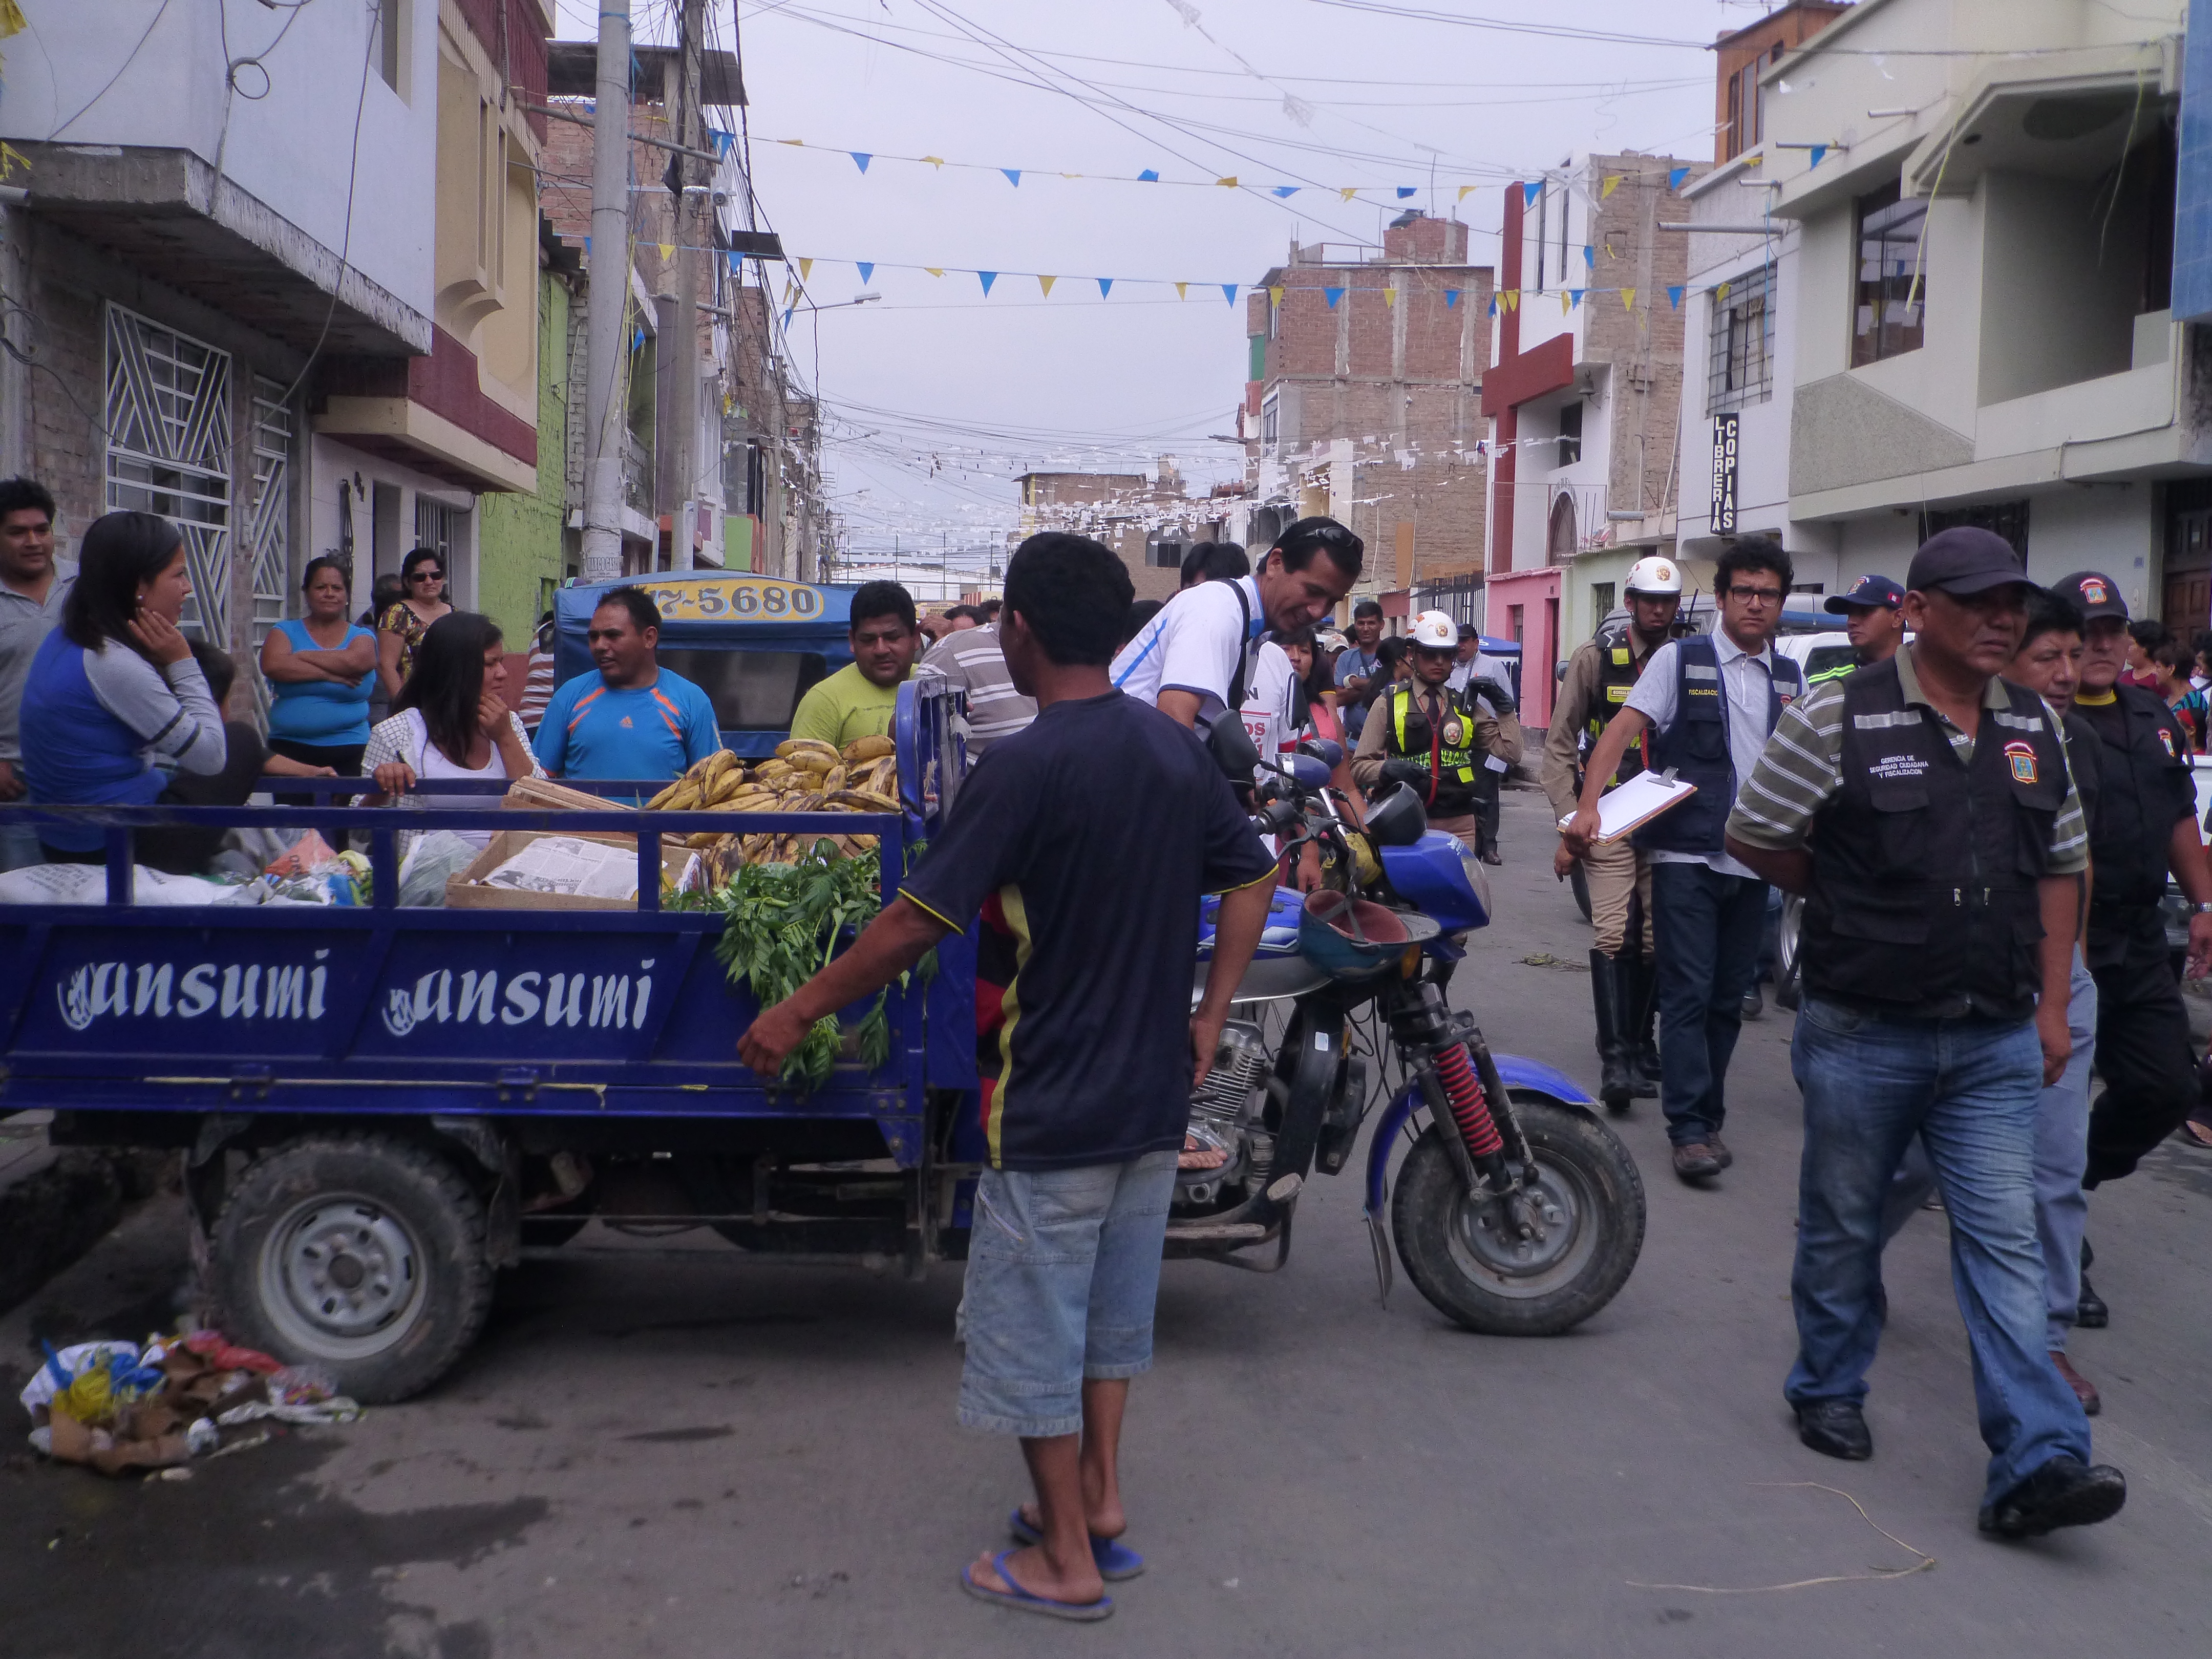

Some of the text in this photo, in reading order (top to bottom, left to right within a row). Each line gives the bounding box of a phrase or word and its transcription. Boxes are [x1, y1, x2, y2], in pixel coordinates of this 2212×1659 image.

[1712, 416, 1725, 531] LIBRERIA
[1722, 420, 1736, 528] COPIAS
[587, 557, 605, 571] MARCO
[649, 586, 816, 616] 7-5680
[1881, 755, 1906, 764] GERENCIA
[1869, 763, 1898, 773] SEGURIDAD
[1879, 770, 1883, 779] Y
